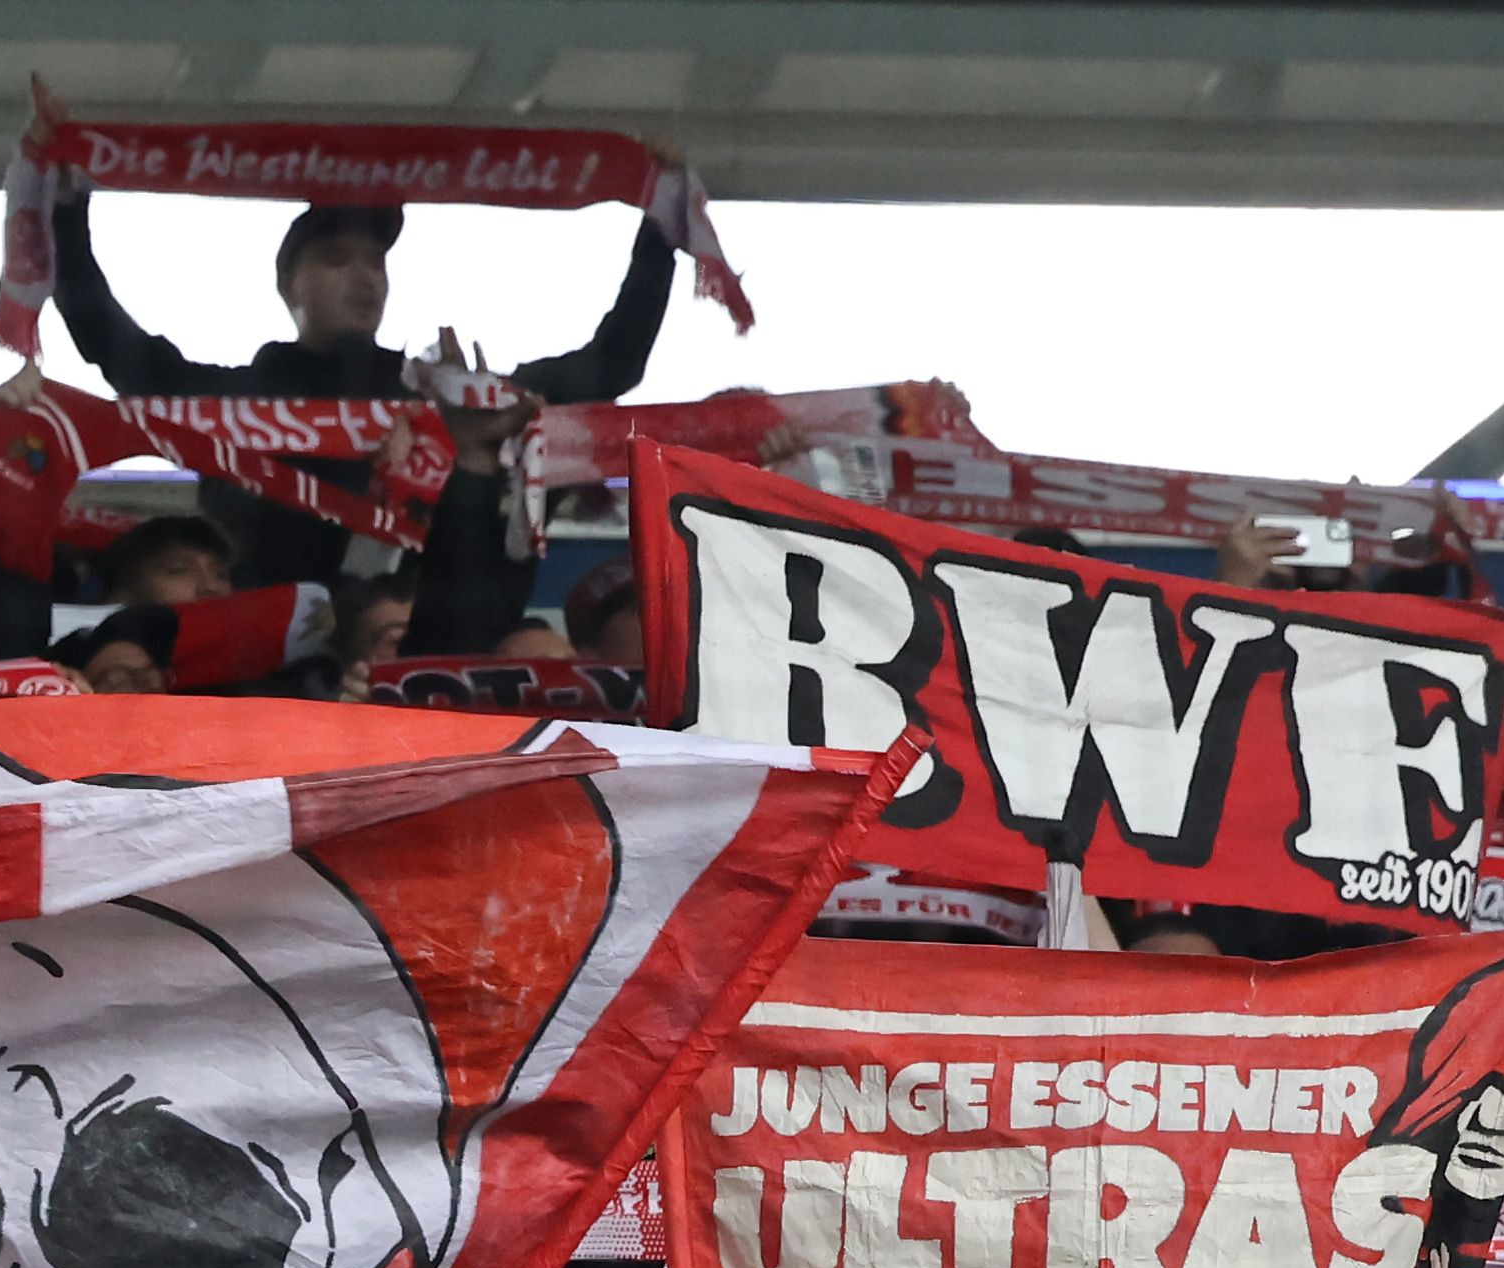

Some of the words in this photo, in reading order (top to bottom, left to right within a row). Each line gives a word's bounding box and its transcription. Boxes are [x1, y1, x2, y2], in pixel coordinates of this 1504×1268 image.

[81, 131, 167, 177] Die
[185, 137, 449, 190] Westkurve
[464, 149, 559, 192] lebt
[1341, 855, 1412, 904] seit
[1416, 858, 1477, 922] 190
[710, 1062, 991, 1138] JUNGE
[1009, 1060, 1380, 1137] ESSENER
